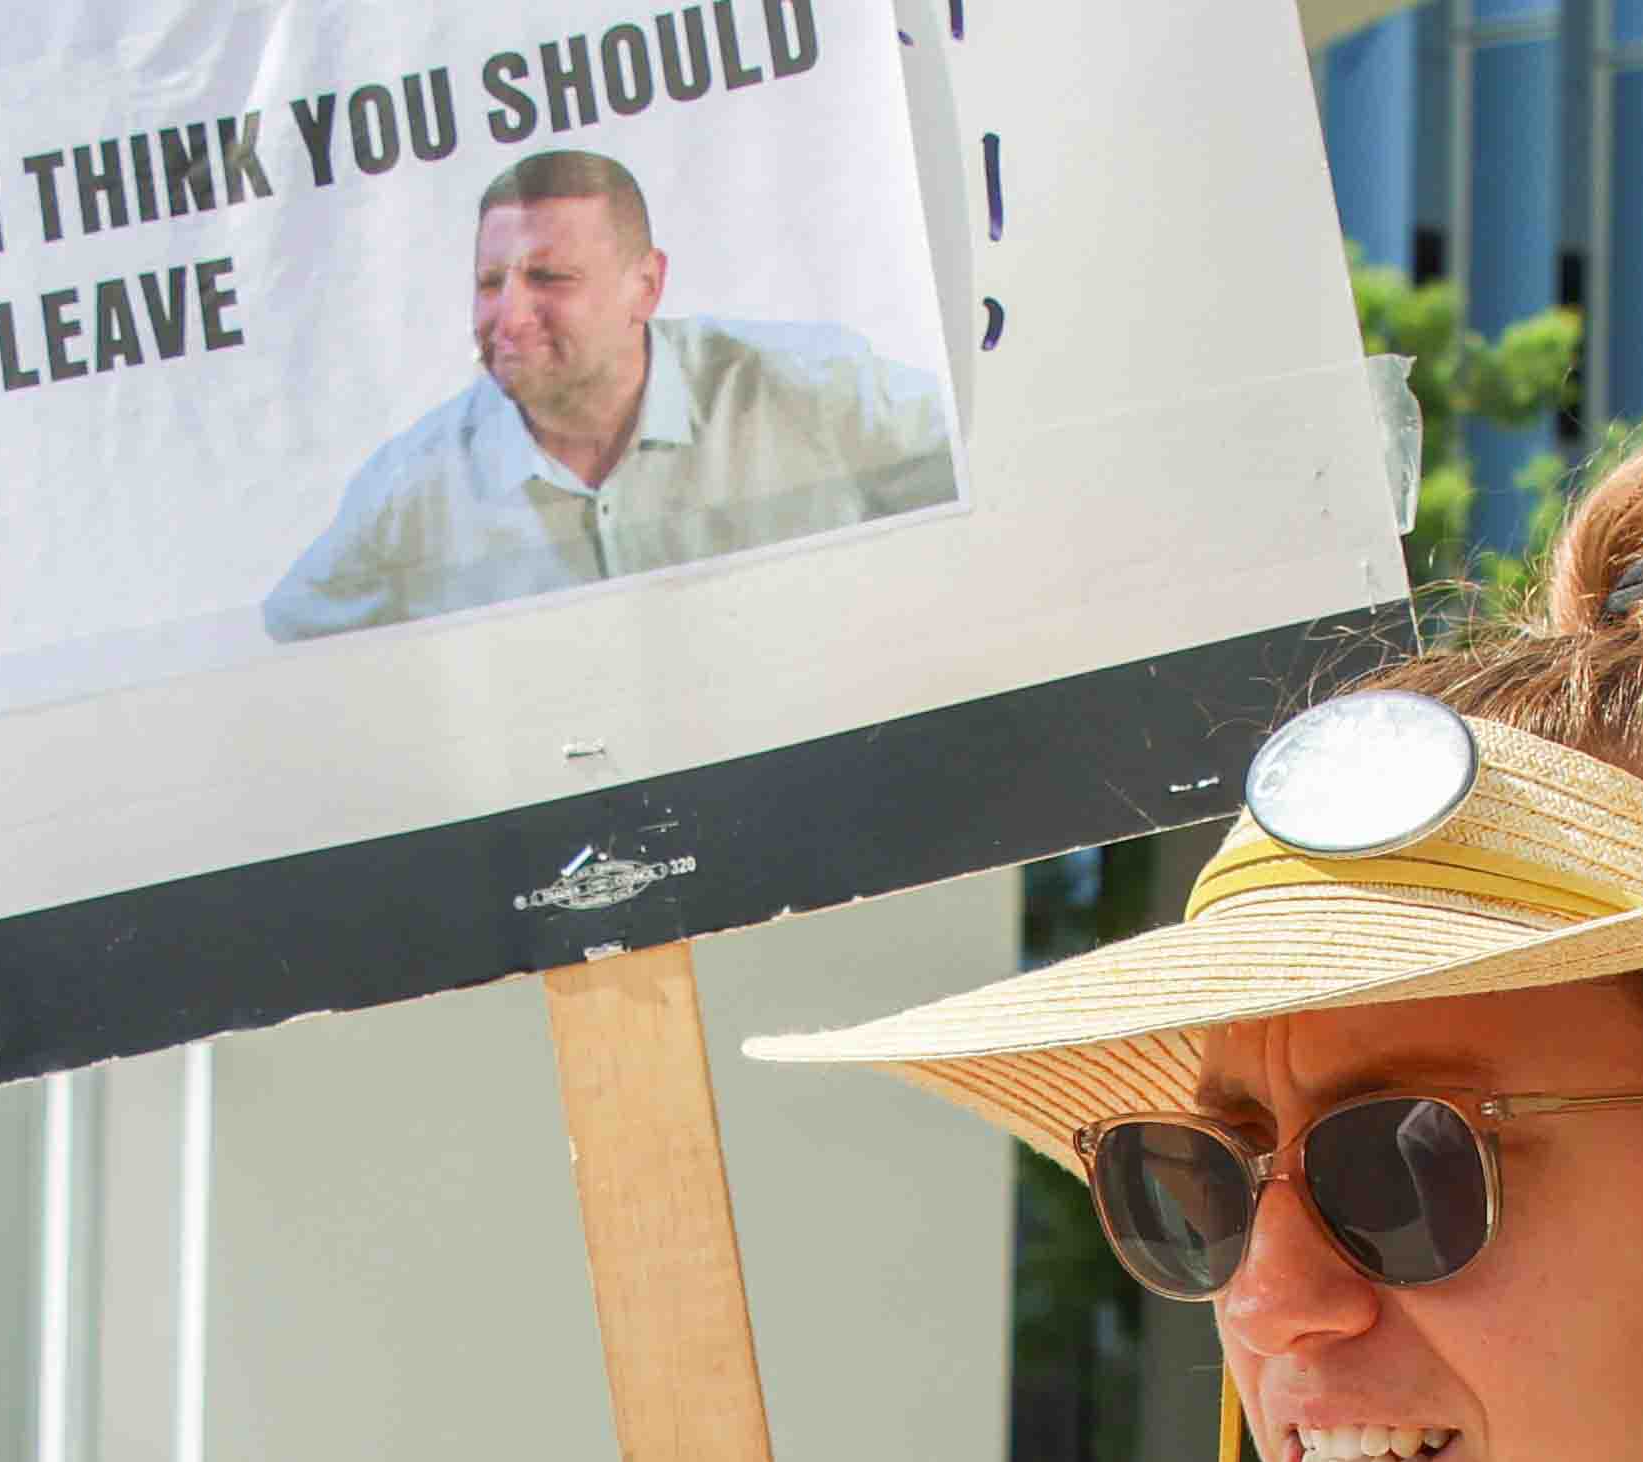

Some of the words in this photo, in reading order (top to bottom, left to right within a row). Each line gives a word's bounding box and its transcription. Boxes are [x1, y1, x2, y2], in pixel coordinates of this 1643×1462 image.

[23, 109, 274, 243] THINK
[290, 65, 457, 187] YOU
[482, 0, 819, 144] SHOULD
